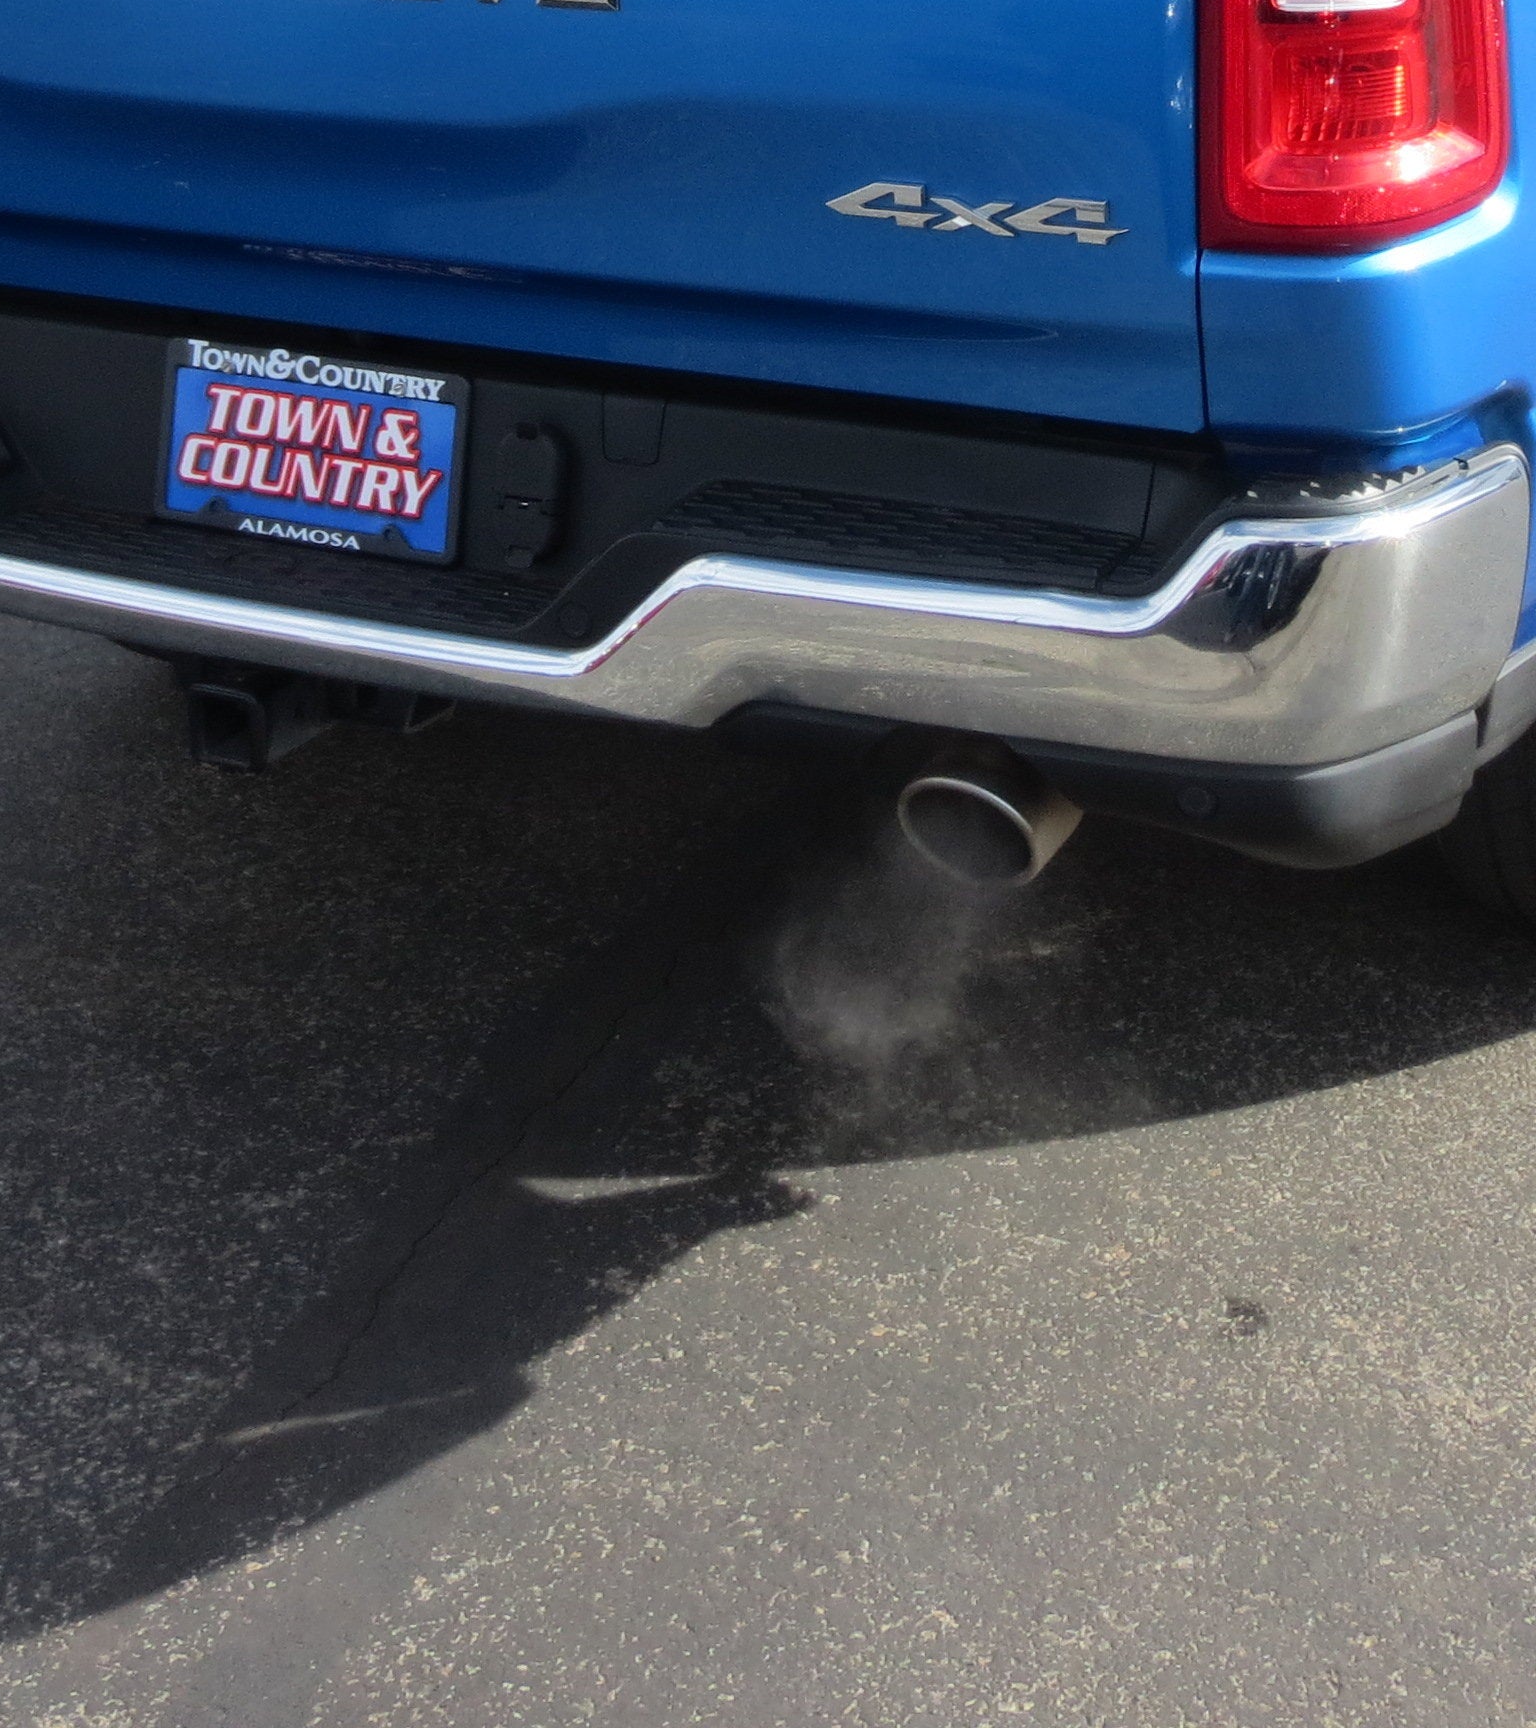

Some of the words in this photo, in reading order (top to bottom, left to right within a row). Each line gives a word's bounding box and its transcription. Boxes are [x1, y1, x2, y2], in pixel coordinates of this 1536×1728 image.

[825, 181, 1130, 246] 4x4
[207, 382, 371, 455] TOWN
[373, 406, 421, 463] &
[177, 433, 443, 520] COUNTRY
[237, 517, 361, 552] ALAMOSA
